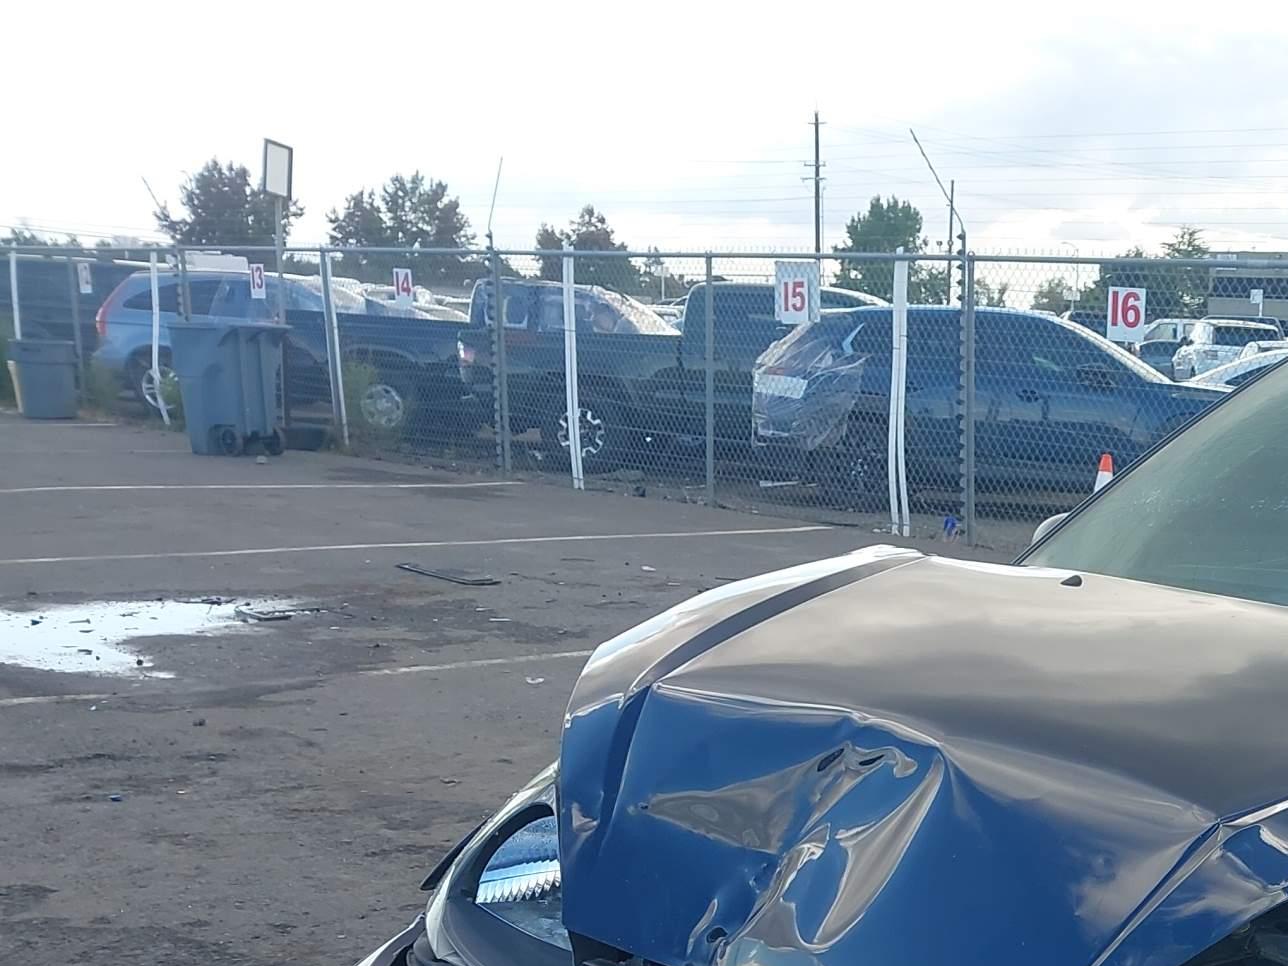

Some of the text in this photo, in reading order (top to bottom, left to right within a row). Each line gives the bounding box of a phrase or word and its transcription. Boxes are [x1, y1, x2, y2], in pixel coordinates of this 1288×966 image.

[251, 266, 264, 290] 13
[395, 271, 412, 297] 14
[783, 281, 806, 312] 15
[1111, 290, 1141, 328] 16
